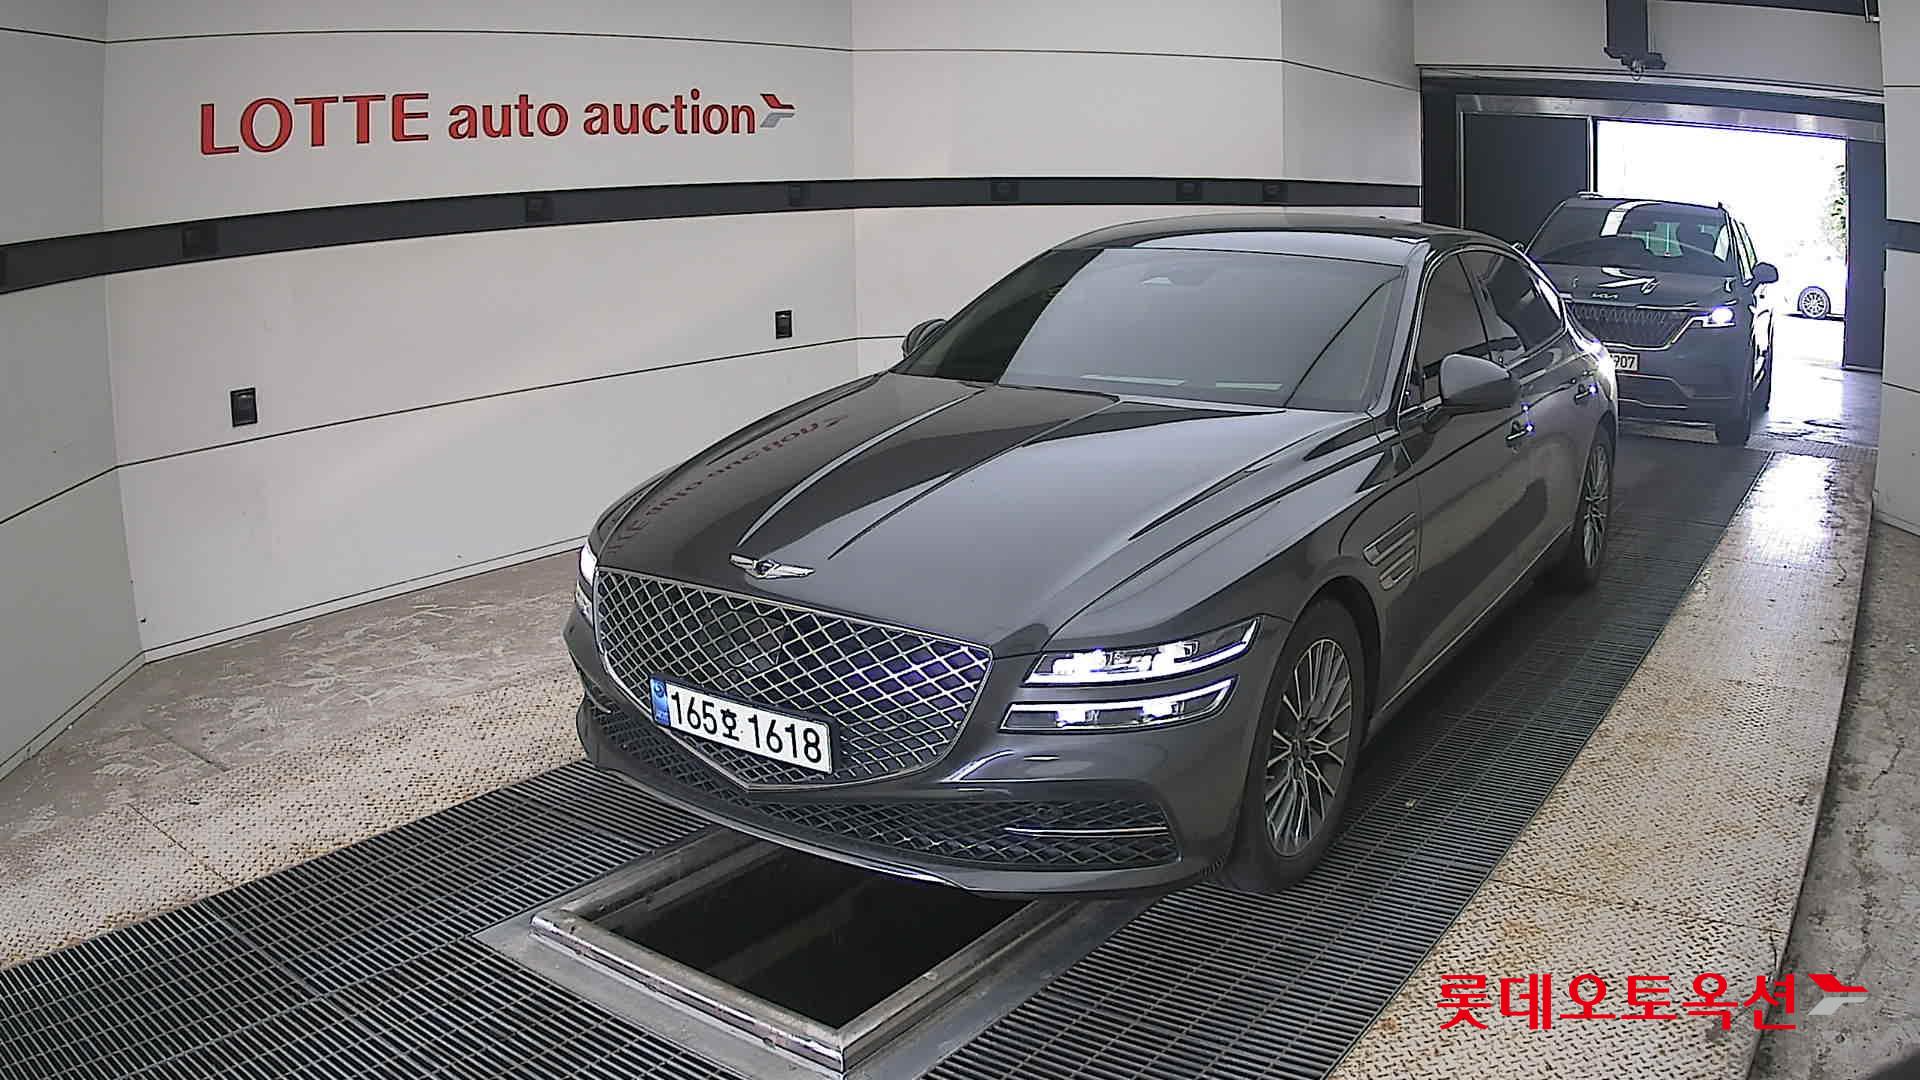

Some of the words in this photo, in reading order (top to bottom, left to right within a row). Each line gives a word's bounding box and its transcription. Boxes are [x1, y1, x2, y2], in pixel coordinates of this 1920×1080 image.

[201, 92, 430, 155] LOTTE
[448, 94, 570, 139] auto
[583, 89, 757, 135] auction
